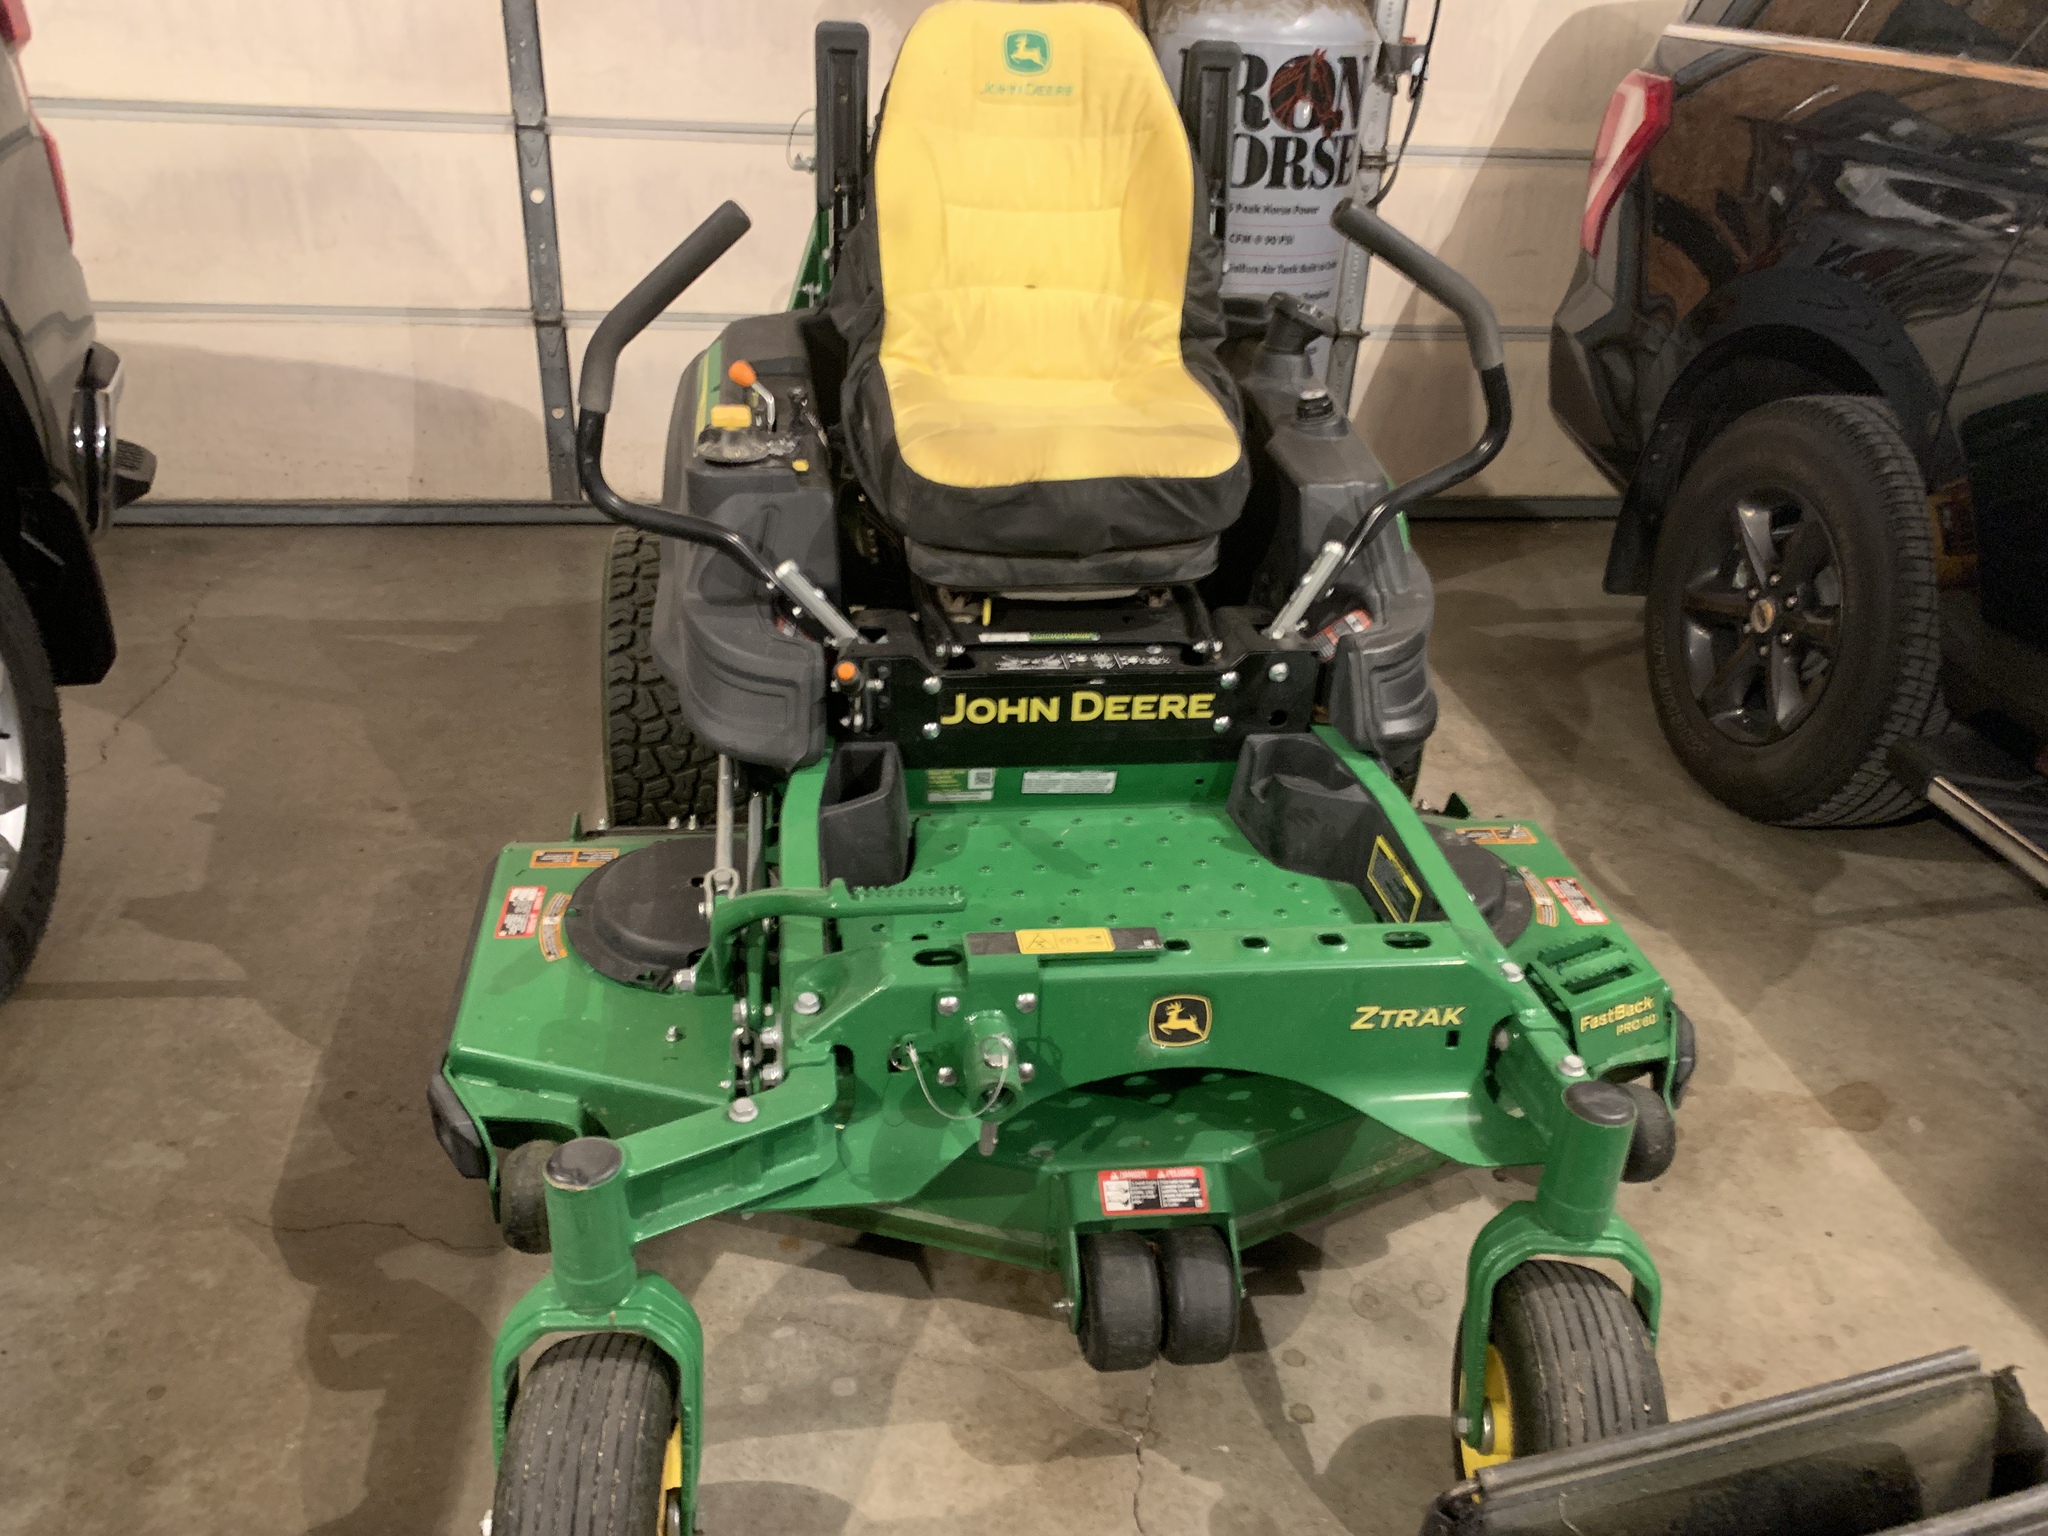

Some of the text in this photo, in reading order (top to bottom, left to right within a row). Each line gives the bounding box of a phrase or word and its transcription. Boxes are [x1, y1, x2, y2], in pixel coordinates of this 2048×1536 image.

[940, 690, 1217, 726] JOHN DEERE
[1350, 1005, 1467, 1030] ZTRAK
[1580, 995, 1655, 1033] FastBack
[1616, 1018, 1642, 1036] PRO
